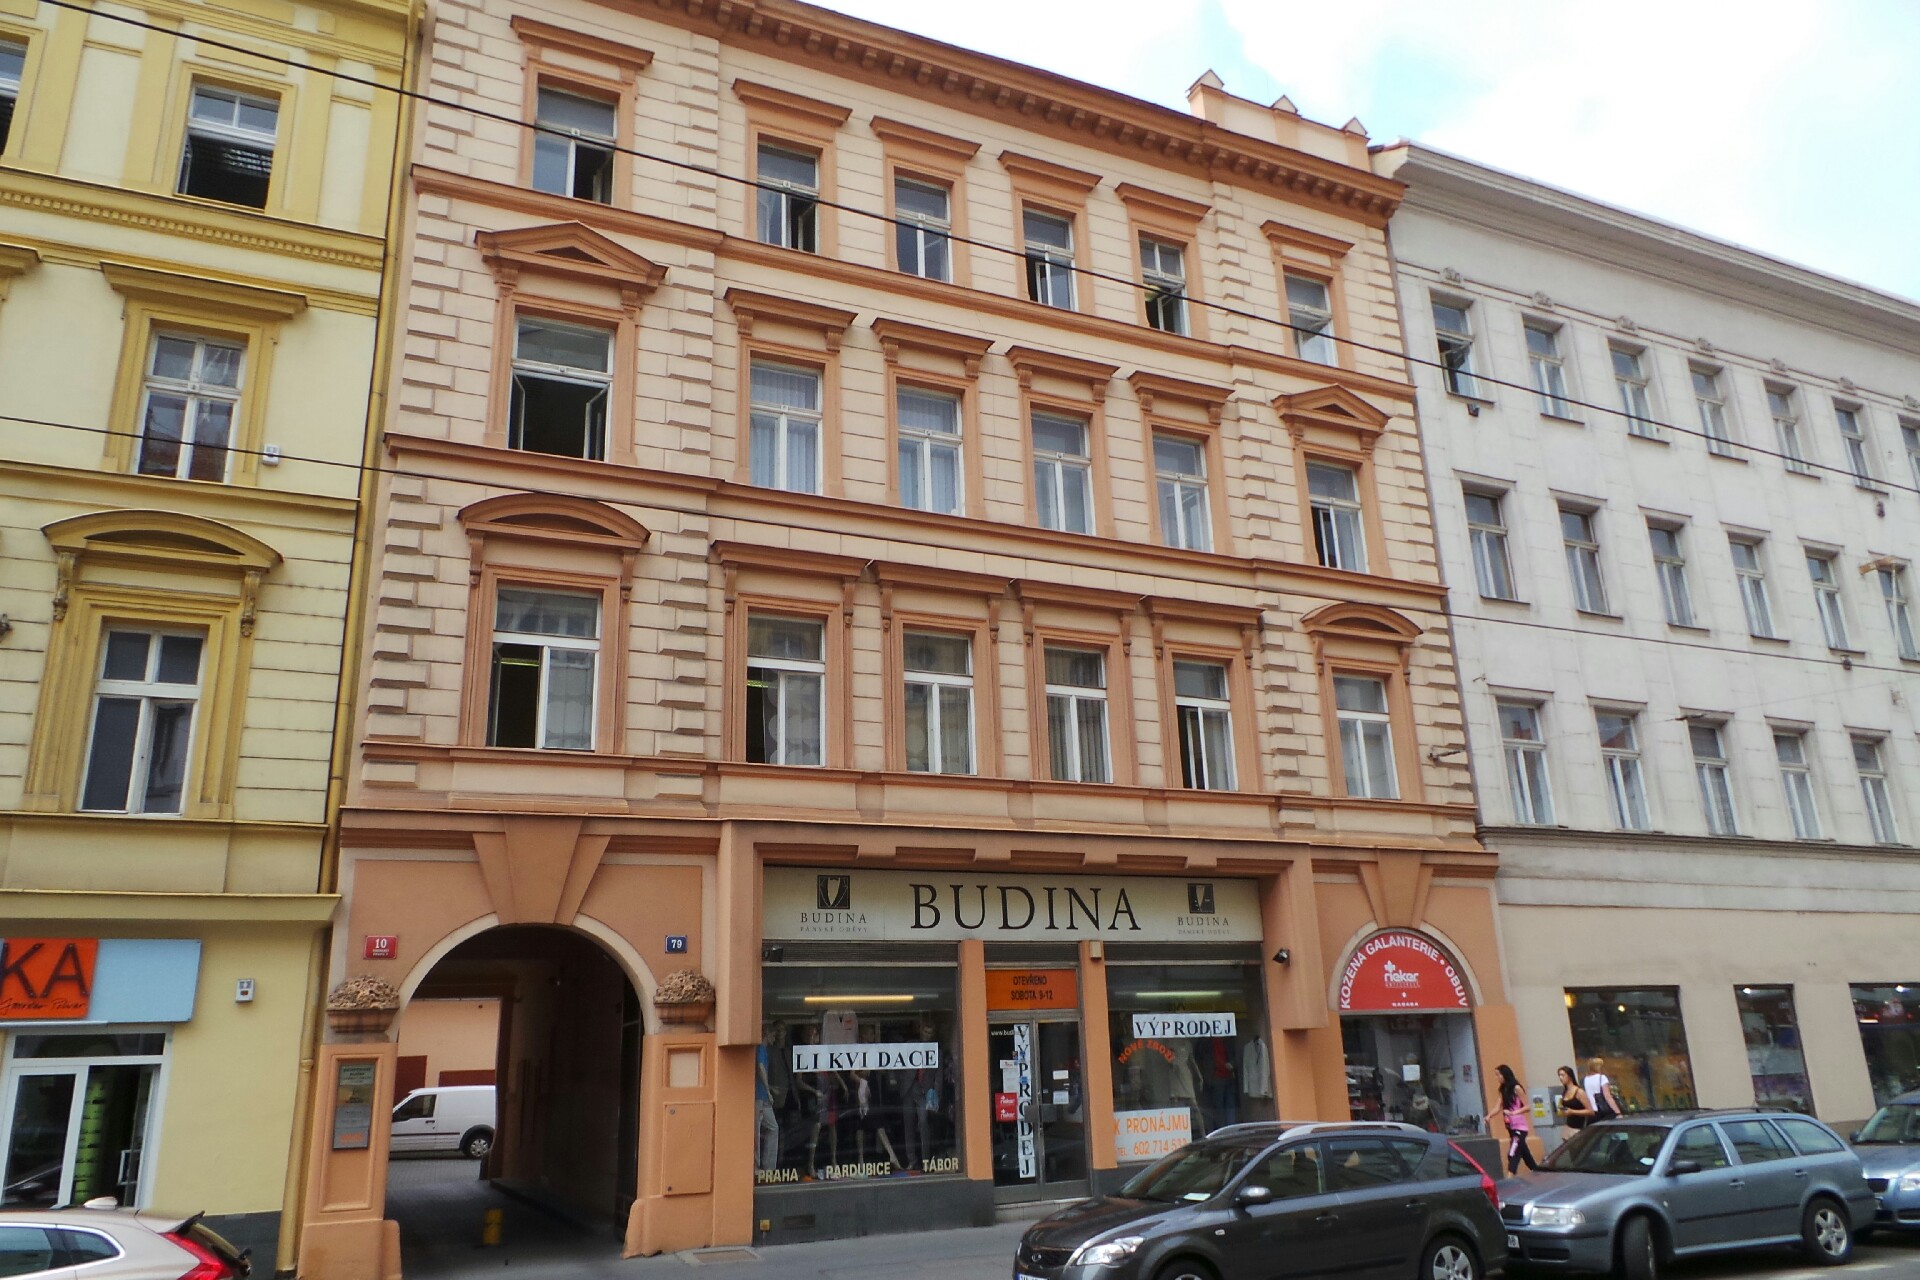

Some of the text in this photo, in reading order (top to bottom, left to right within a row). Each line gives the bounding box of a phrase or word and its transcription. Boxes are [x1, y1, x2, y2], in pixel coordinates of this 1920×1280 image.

[909, 884, 1141, 931] BUDINA
[801, 913, 867, 923] BUDINA
[1177, 916, 1229, 926] BUDINA
[375, 938, 387, 949] 10
[671, 939, 683, 949] 79
[1365, 936, 1440, 962] GALANTERIE
[1444, 965, 1468, 1007] OBUV
[1384, 969, 1419, 982] rieker
[1013, 974, 1048, 986] OTEVŘENO
[1010, 990, 1053, 1001] SOBOTA 9-12
[1135, 1017, 1231, 1036] VÝPRODEJ
[1126, 1111, 1189, 1135] PRONÁJMU
[1134, 1141, 1150, 1156] 602
[1153, 1139, 1169, 1153] 714
[826, 1162, 891, 1179] PARDUBICE
[922, 1156, 960, 1173] TÁBOR
[758, 1168, 799, 1183] PRAHA
